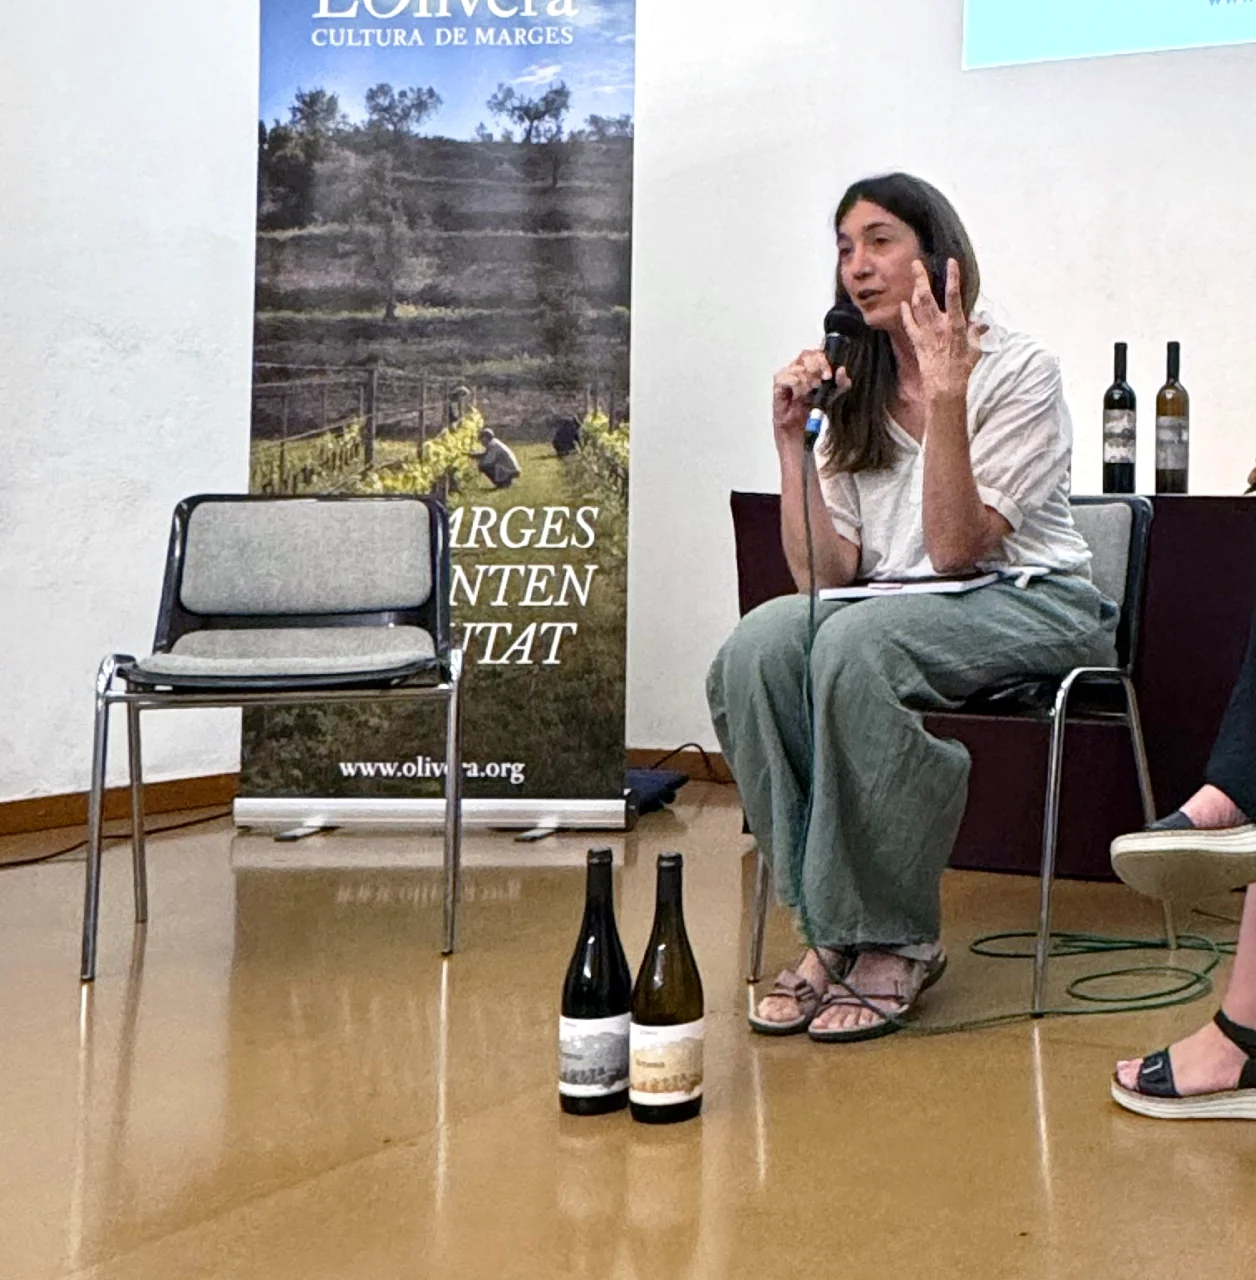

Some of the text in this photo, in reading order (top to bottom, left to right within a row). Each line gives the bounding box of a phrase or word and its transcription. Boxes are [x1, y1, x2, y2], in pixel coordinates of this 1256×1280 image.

[310, 25, 575, 47] CULTURA DE MARGES
[449, 505, 600, 549] ARGES
[449, 564, 599, 608] NTEN
[338, 755, 526, 785] www.oliva.org
